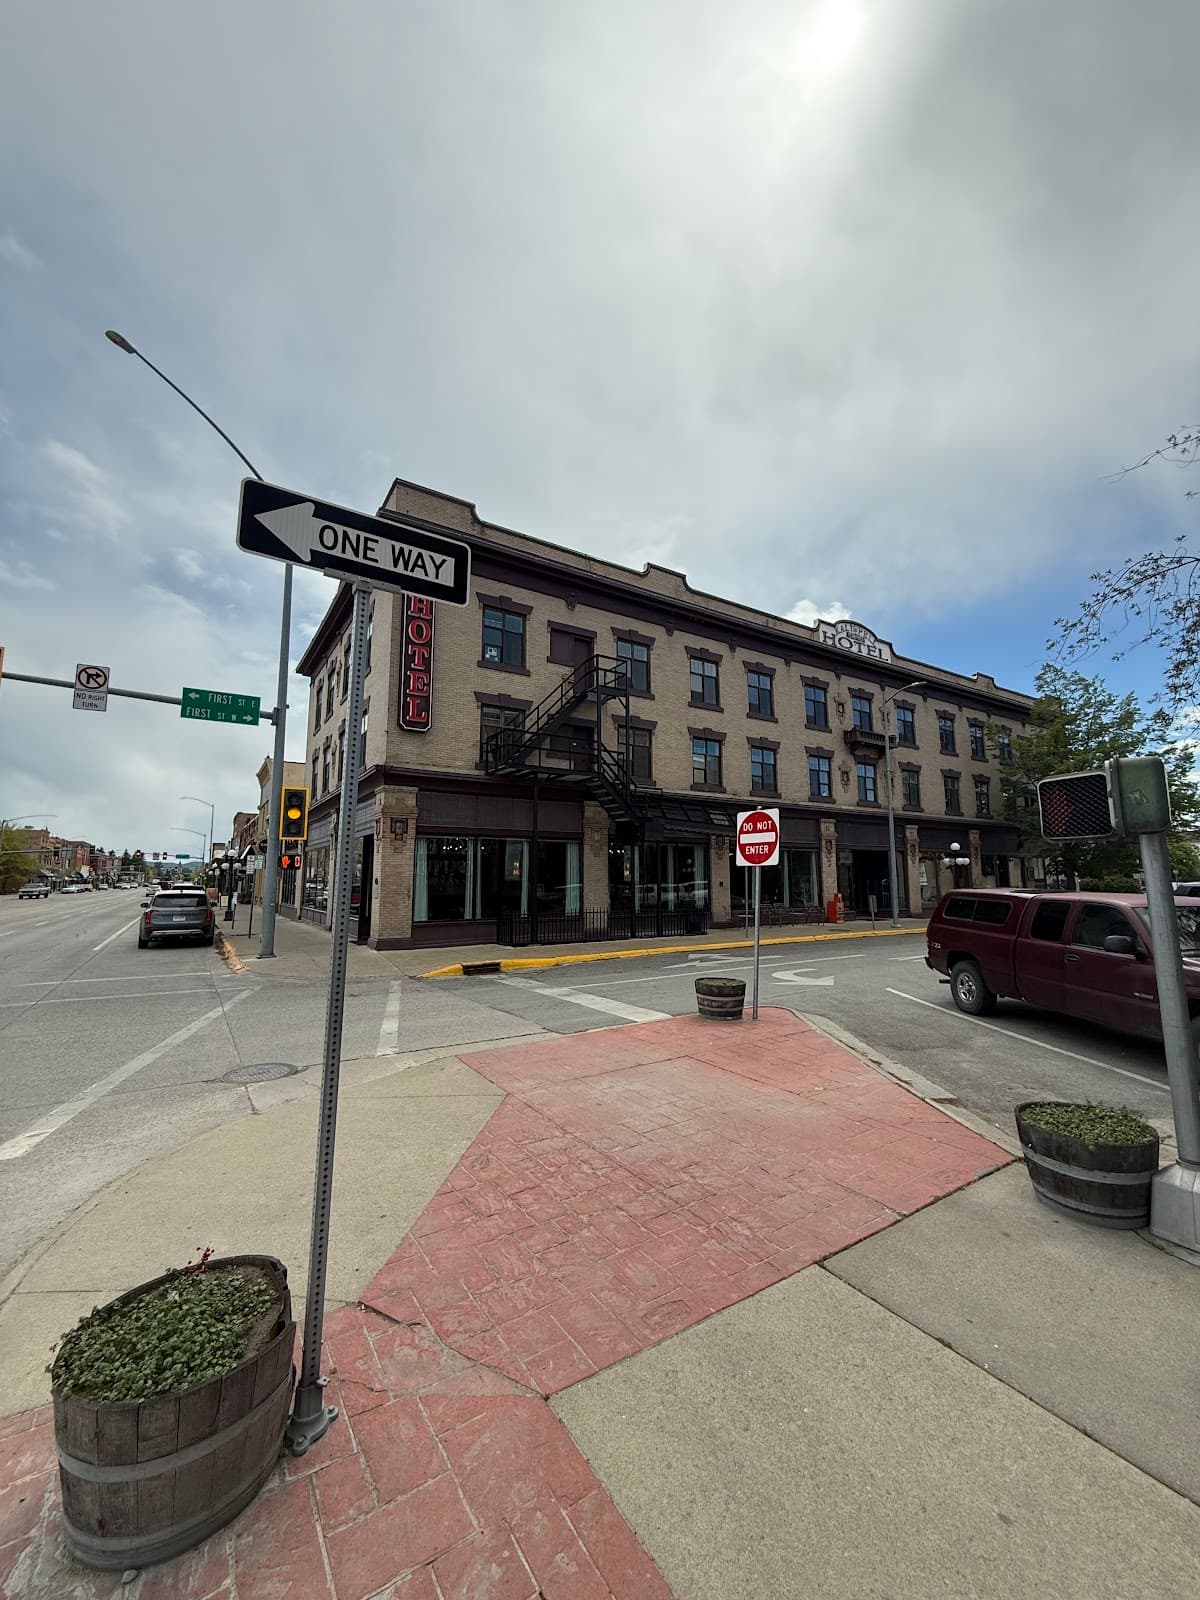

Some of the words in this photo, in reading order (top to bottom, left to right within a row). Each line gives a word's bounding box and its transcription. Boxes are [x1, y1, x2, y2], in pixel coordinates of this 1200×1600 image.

[318, 524, 380, 564] ONE
[391, 543, 448, 580] WAY
[821, 630, 889, 661] HOTEL
[407, 595, 432, 722] HOTEL
[75, 692, 87, 700] NO
[88, 694, 106, 703] RIGHT
[208, 693, 233, 705] FIRST
[238, 698, 246, 708] ST
[251, 700, 257, 708] E
[82, 701, 99, 709] TURN
[186, 706, 212, 719] FIRST
[216, 712, 225, 720] ST
[743, 822, 753, 831] DO
[757, 821, 772, 830] NOT
[746, 845, 769, 854] ENTER
